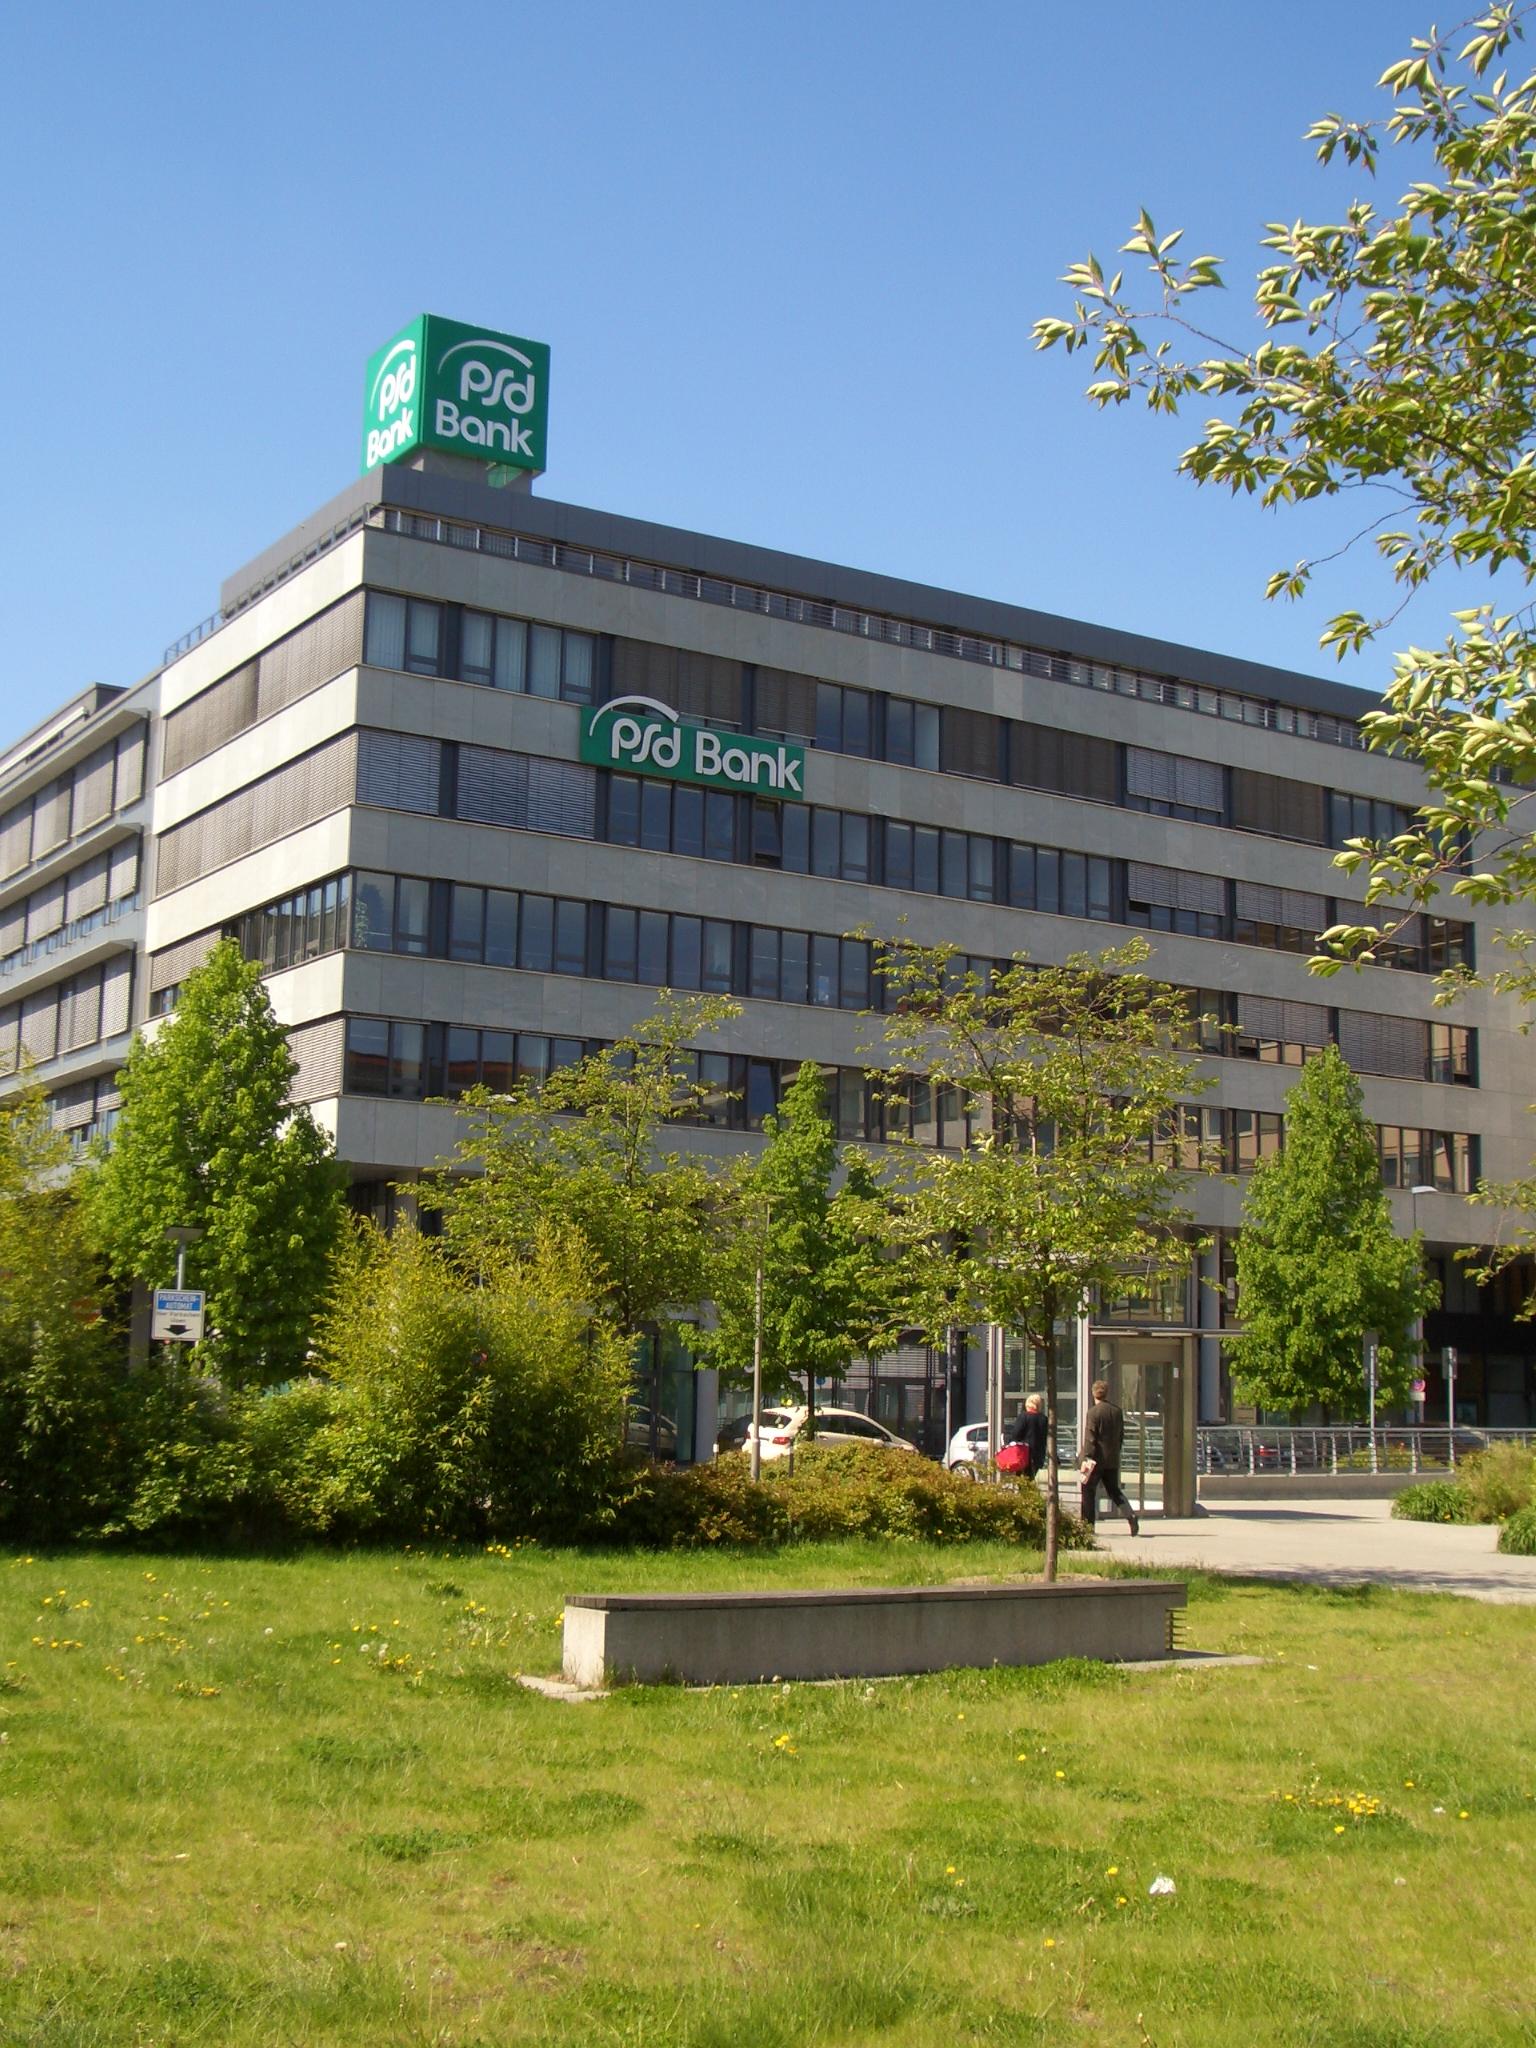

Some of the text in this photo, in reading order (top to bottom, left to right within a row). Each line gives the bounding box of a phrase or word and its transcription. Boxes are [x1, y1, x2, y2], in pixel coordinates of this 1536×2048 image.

[379, 354, 417, 421] psd
[460, 360, 535, 415] psd
[366, 407, 414, 468] Bank
[435, 399, 534, 457] Bank
[611, 718, 802, 792] psd Bank
